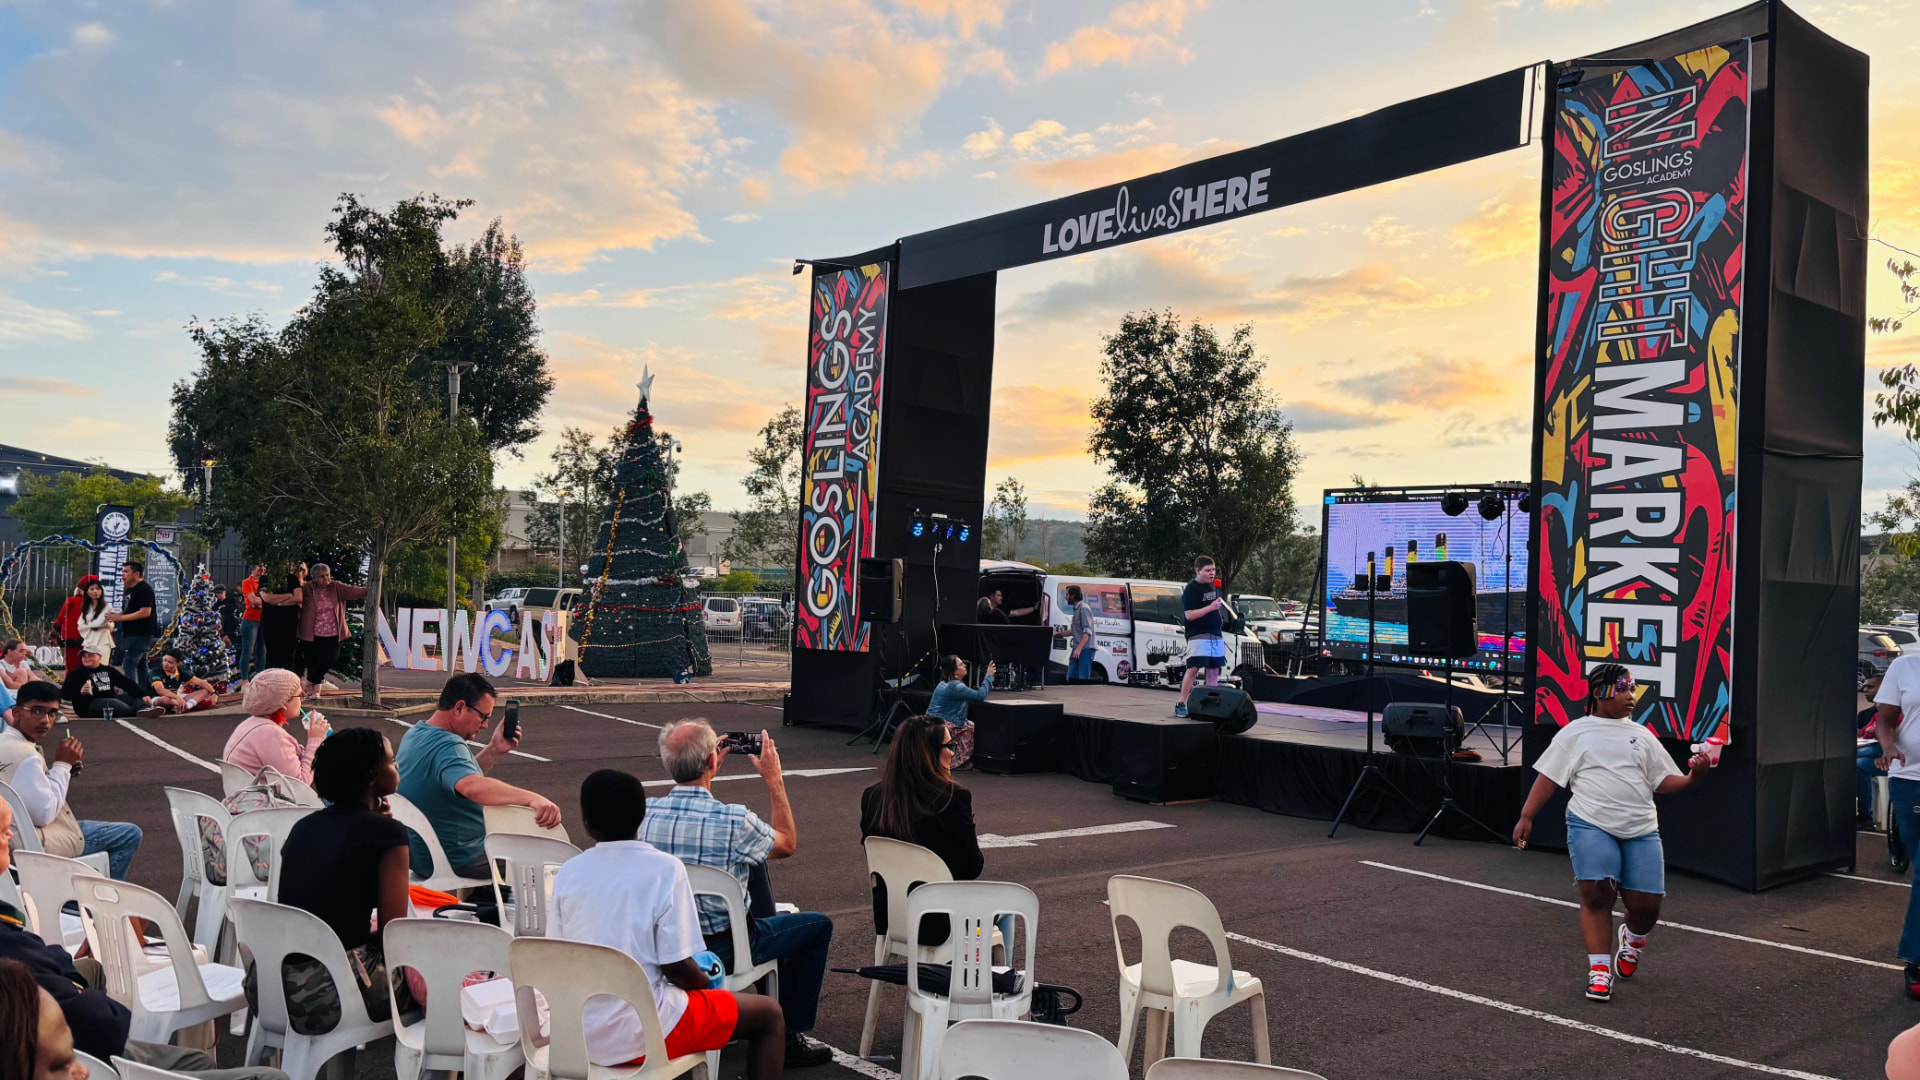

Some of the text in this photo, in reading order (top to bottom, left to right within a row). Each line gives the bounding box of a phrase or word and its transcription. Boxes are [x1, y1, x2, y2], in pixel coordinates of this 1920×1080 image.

[1604, 151, 1693, 183] GOSLINGS
[1646, 167, 1692, 185] ACADEMY
[851, 307, 876, 460] ACADEMY
[807, 309, 852, 618] GOSLINGS
[1586, 359, 1686, 698] MARKET
